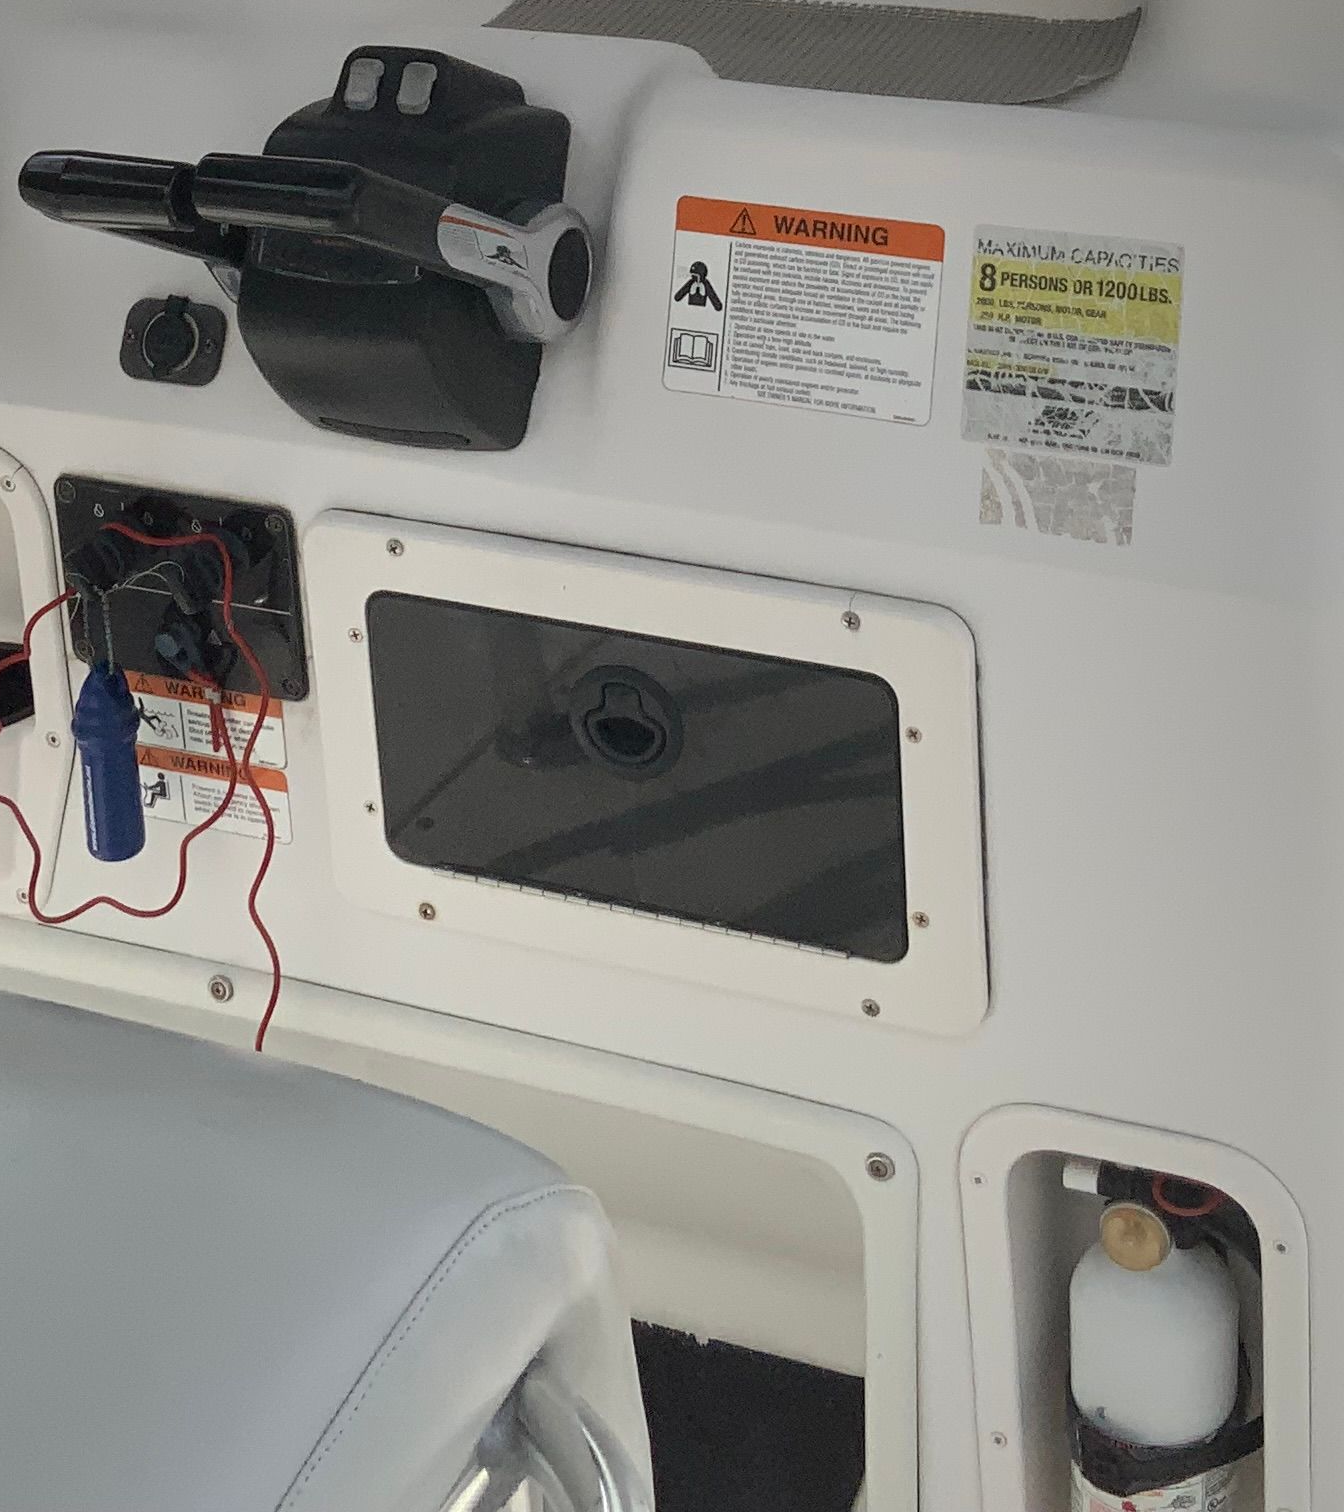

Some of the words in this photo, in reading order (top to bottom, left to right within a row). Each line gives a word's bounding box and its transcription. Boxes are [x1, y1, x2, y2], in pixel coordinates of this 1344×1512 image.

[773, 215, 889, 247] WARNING
[979, 263, 996, 292] 8
[1000, 271, 1068, 294] PERSONS
[1073, 280, 1093, 296] OR
[1098, 280, 1138, 301] 1200
[1140, 287, 1172, 304] LBS.
